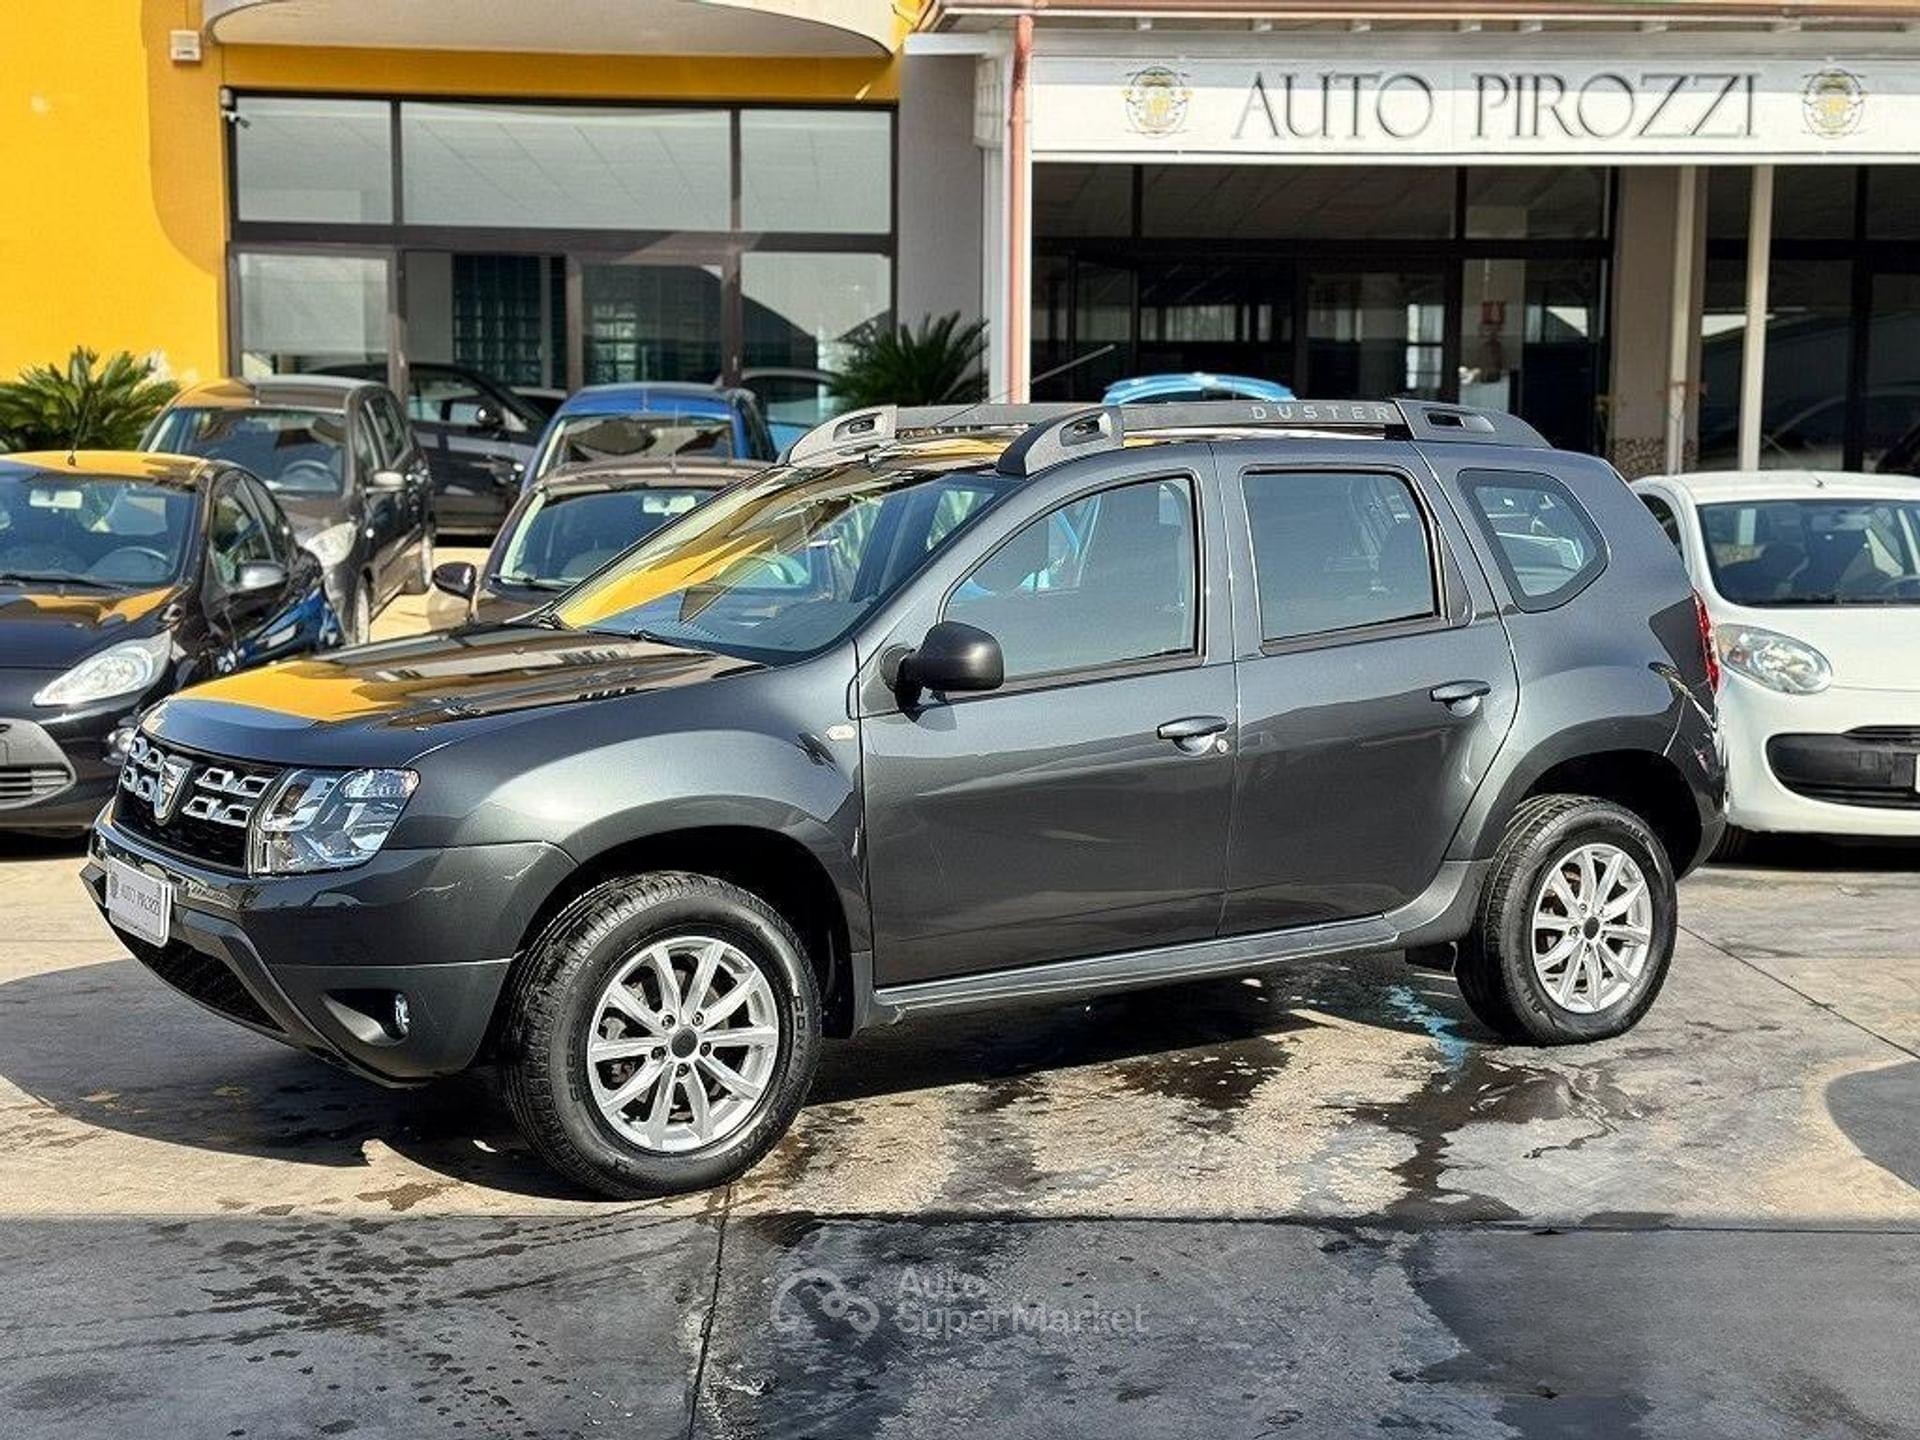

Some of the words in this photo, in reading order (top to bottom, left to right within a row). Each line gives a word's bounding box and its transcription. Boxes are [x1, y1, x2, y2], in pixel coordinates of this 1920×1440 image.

[1231, 72, 1434, 139] AUTO
[1471, 73, 1760, 139] PIROZZI
[1252, 405, 1391, 420] DUSTER
